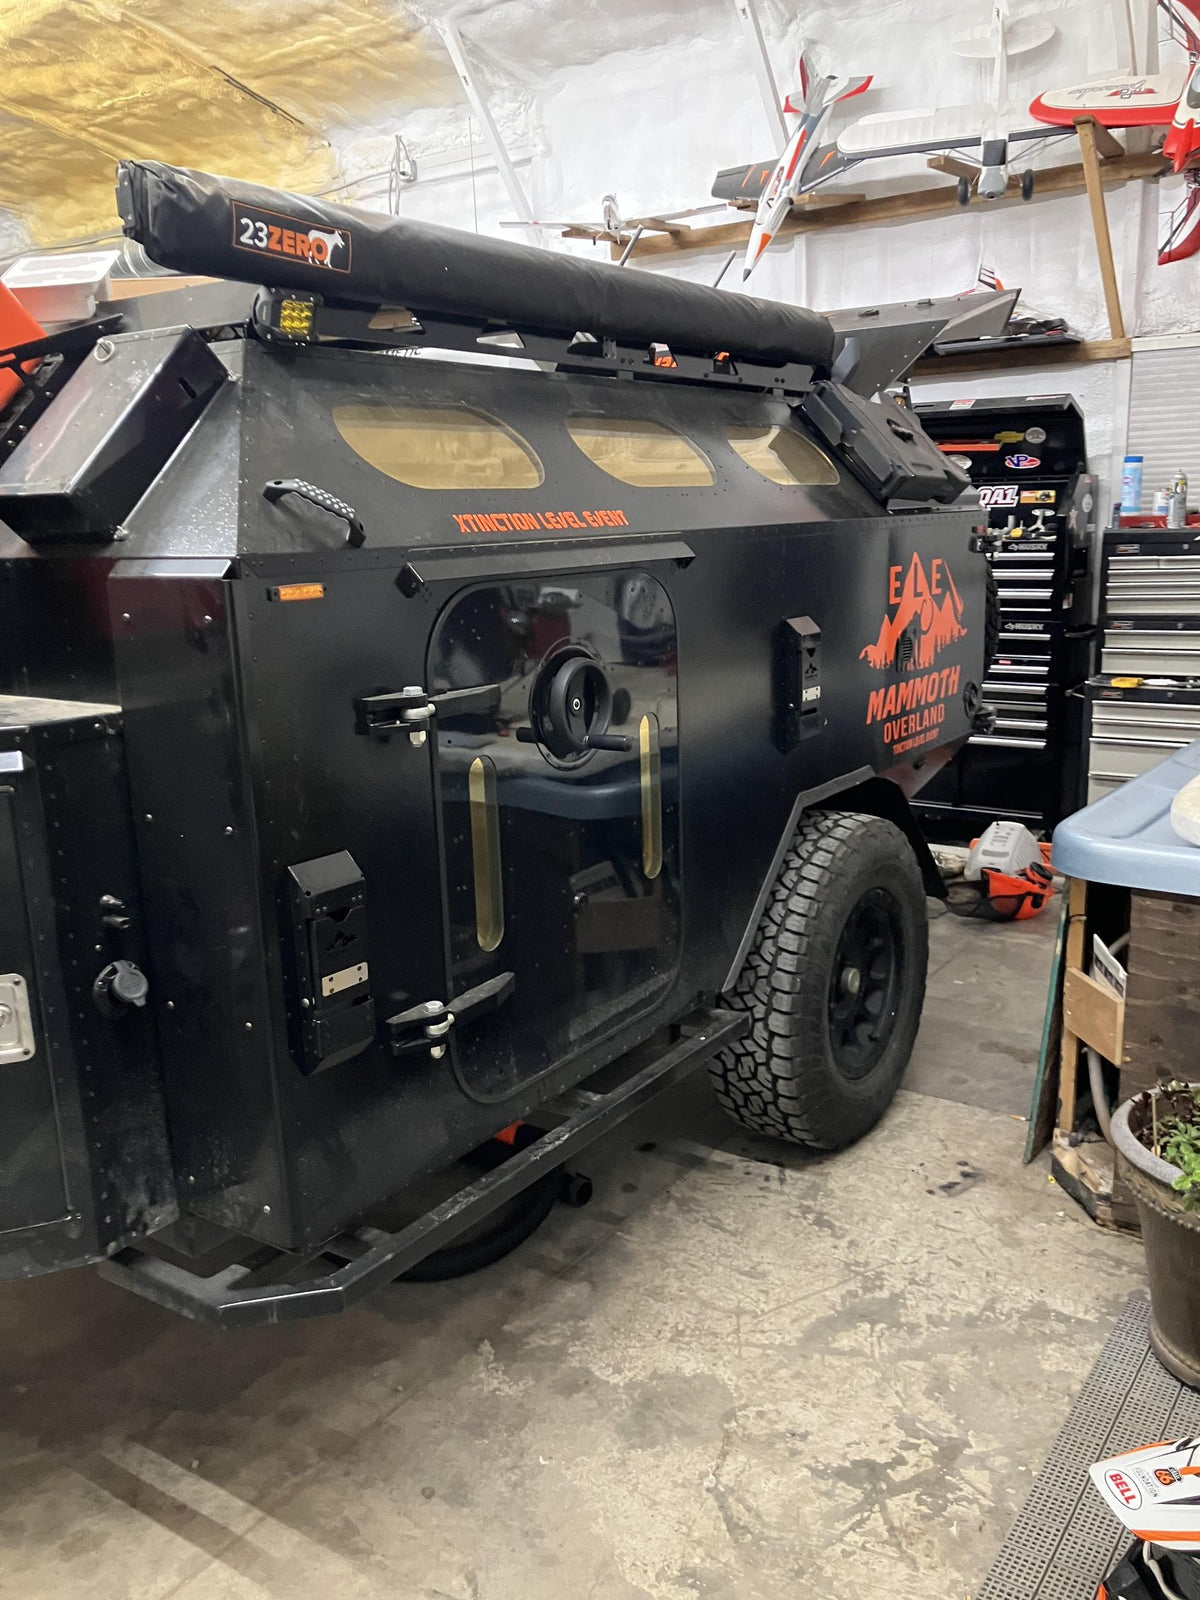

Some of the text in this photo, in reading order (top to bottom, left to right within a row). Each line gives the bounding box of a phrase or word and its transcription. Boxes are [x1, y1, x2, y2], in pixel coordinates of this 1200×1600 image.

[239, 217, 329, 261] 23ZERO
[978, 486, 1018, 508] QA1
[536, 511, 587, 530] LEVEL
[582, 509, 629, 528] EVENT
[1014, 623, 1045, 631] HUSKY
[866, 664, 961, 725] MAMMOTH
[883, 703, 945, 743] OVERLAND
[1108, 1472, 1137, 1505] BELL
